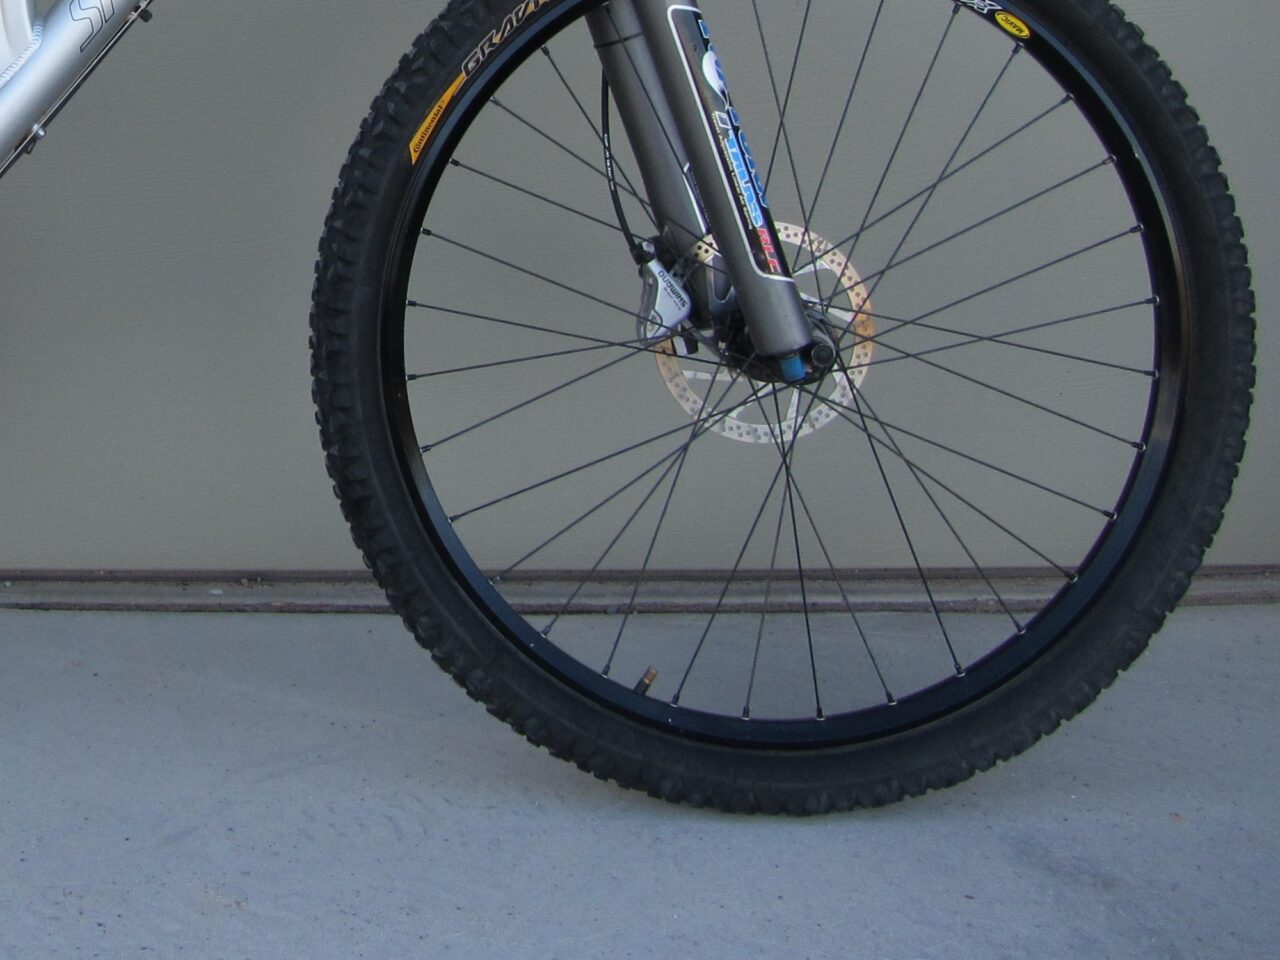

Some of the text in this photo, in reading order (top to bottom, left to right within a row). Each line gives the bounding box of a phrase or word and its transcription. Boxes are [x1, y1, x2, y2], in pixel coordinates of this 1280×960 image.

[999, 14, 1025, 34] MAVIC
[412, 102, 444, 154] Continental
[657, 270, 688, 308] SHIMANO
